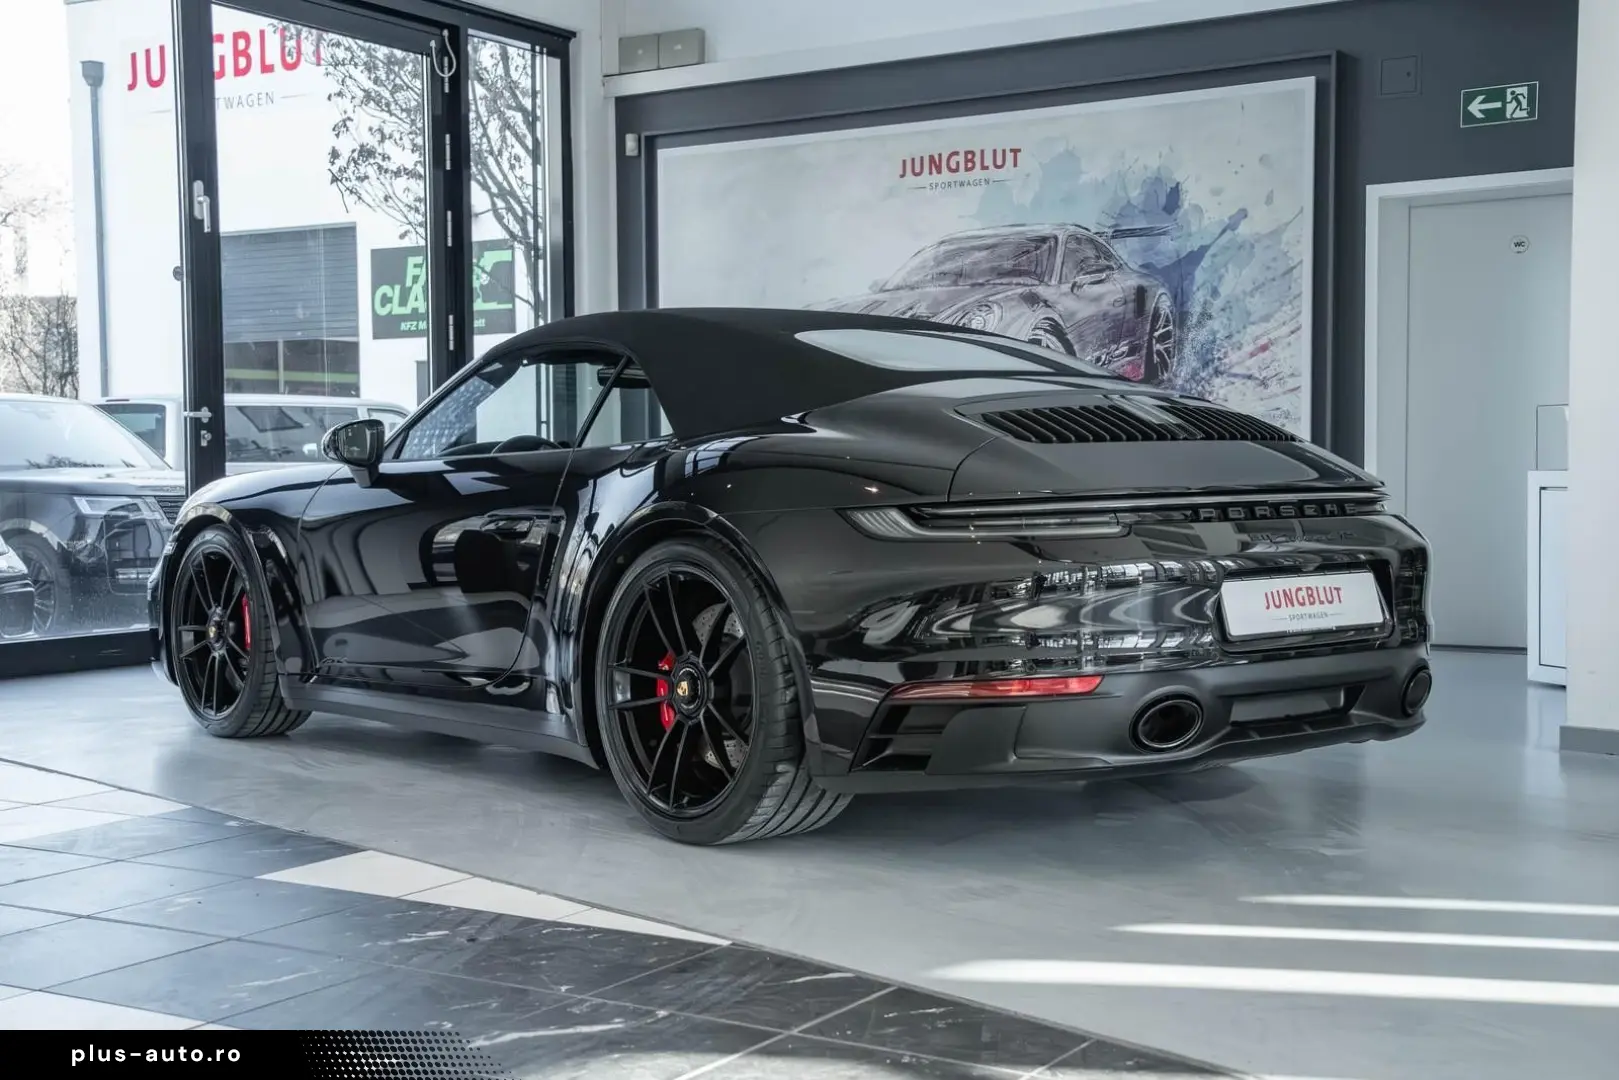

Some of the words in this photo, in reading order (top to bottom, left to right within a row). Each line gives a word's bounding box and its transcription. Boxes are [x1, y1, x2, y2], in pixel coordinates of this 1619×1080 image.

[126, 27, 323, 92] JUGBLUT
[899, 148, 1022, 178] JUNGBLUT
[928, 178, 991, 190] SPORTWAGEN
[400, 320, 418, 331] KFZ
[1199, 502, 1358, 521] PORSCHE
[1264, 586, 1343, 610] JUNGBLUT
[1288, 611, 1329, 623] SPORTWAGEN
